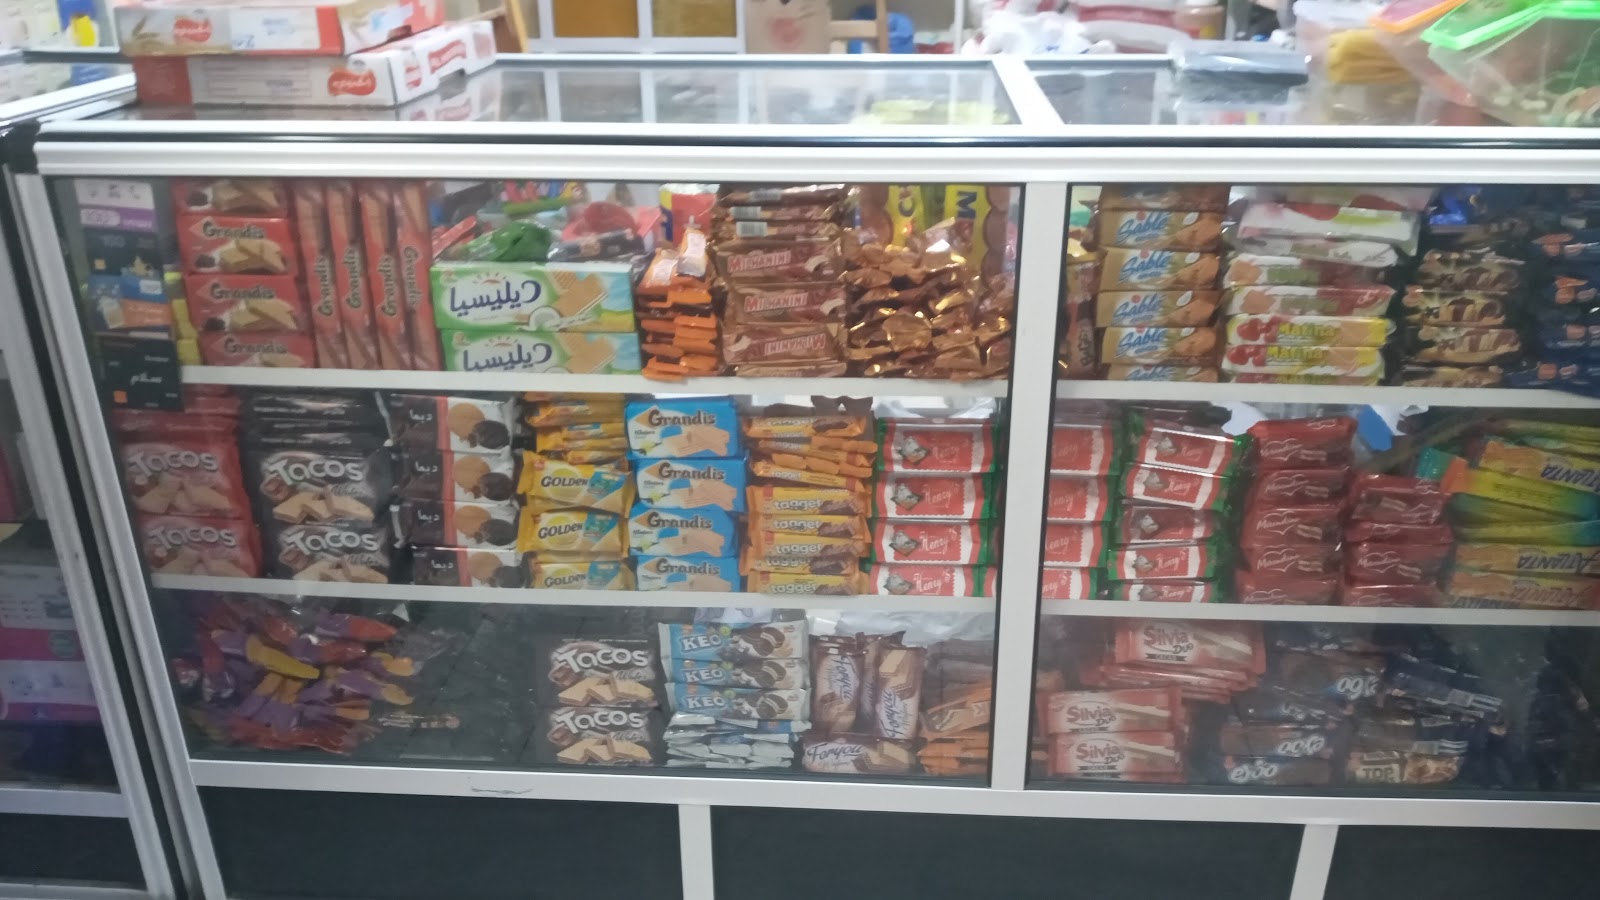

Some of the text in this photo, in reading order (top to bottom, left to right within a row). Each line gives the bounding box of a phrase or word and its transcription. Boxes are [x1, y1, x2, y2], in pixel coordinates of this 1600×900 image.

[203, 220, 265, 238] Grandis
[210, 282, 274, 299] Grandis
[223, 338, 287, 354] Grandis
[649, 409, 716, 427] Grandis
[659, 462, 725, 480] Grandis
[648, 509, 713, 529] Grandis
[656, 558, 720, 575] Grandis
[1516, 551, 1599, 574] ATLANTA
[771, 582, 817, 594] tagger
[1143, 626, 1187, 646] Silvia
[1066, 705, 1113, 722] Silvia
[1076, 743, 1120, 760] Silvia
